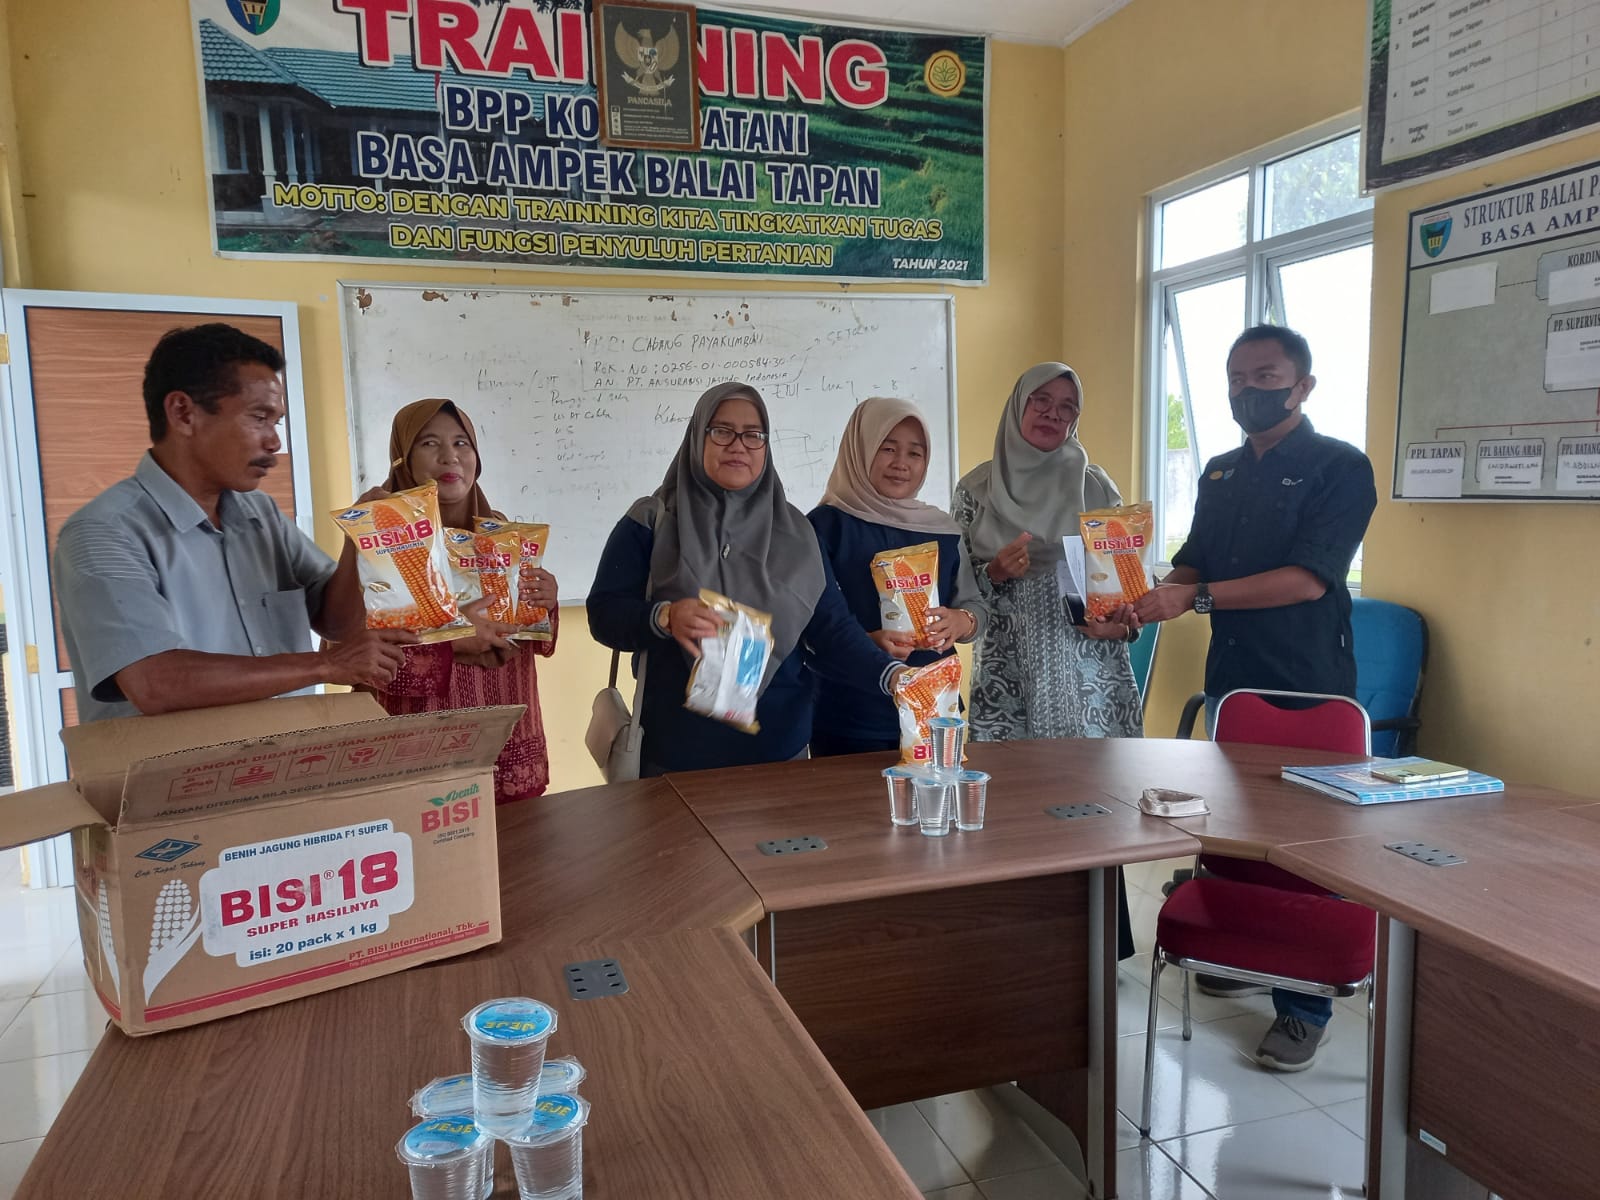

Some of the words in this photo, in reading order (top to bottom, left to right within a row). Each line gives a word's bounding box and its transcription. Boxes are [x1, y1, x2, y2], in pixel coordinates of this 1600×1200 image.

[445, 85, 532, 134] BPP
[627, 97, 672, 106] PANCASILA
[358, 133, 477, 184] BASA
[487, 143, 636, 195] AMPEK
[645, 155, 755, 201] BALAI
[767, 162, 880, 207] TAPAN
[273, 183, 386, 211] MOTTO:
[391, 191, 508, 219] DENGAN
[514, 199, 656, 226] TRAINNING
[661, 207, 717, 231] KITA
[720, 211, 865, 236] TINGKATKAN
[871, 218, 942, 240] TUGAS
[1464, 192, 1535, 228] STRUKTUR
[1540, 178, 1585, 210] BALAI
[1480, 222, 1535, 246] BASA
[1545, 206, 1598, 232] AMP
[391, 225, 453, 249] DAN
[459, 229, 555, 254] FUNGSI
[562, 235, 695, 260] PENYULUH
[701, 241, 832, 266] PERTANIAN
[893, 258, 937, 270] TAHUN
[938, 259, 968, 271] 2021
[1411, 448, 1426, 459] PPL
[1431, 447, 1461, 458] TAPAN
[1480, 446, 1491, 456] PPL
[1493, 445, 1520, 456] BATANG
[359, 531, 400, 549] BISI
[405, 519, 433, 540] 18
[1094, 540, 1120, 550] BISI
[1126, 534, 1145, 548] 18
[460, 558, 489, 568] BISI
[886, 579, 909, 589] BISI
[913, 573, 932, 586] 18
[183, 758, 247, 774] JANGAN
[251, 744, 334, 762] DIBANTING
[337, 738, 367, 748] DAN
[428, 723, 480, 734] DIBALIK
[154, 805, 204, 817] JANGAN
[206, 795, 259, 808] DITERIMA
[262, 789, 287, 799] BILA
[421, 797, 479, 833] BISI
[225, 849, 257, 861] BENIH
[259, 840, 300, 855] JAGUNG
[304, 832, 342, 846] HIBRIDA
[345, 830, 355, 839] F1
[358, 823, 388, 835] SUPER
[338, 851, 399, 900] 18
[247, 917, 298, 937] SUPER
[306, 899, 379, 923] HASILNYA
[250, 947, 271, 960] isi:
[276, 941, 293, 954] 20
[298, 933, 332, 951] pack
[336, 930, 345, 939] x
[349, 926, 355, 935] 1
[361, 922, 377, 934] kg
[349, 950, 364, 960] PT.
[368, 945, 387, 956] BISI
[391, 928, 453, 949] International,
[456, 921, 476, 932] Tbk.
